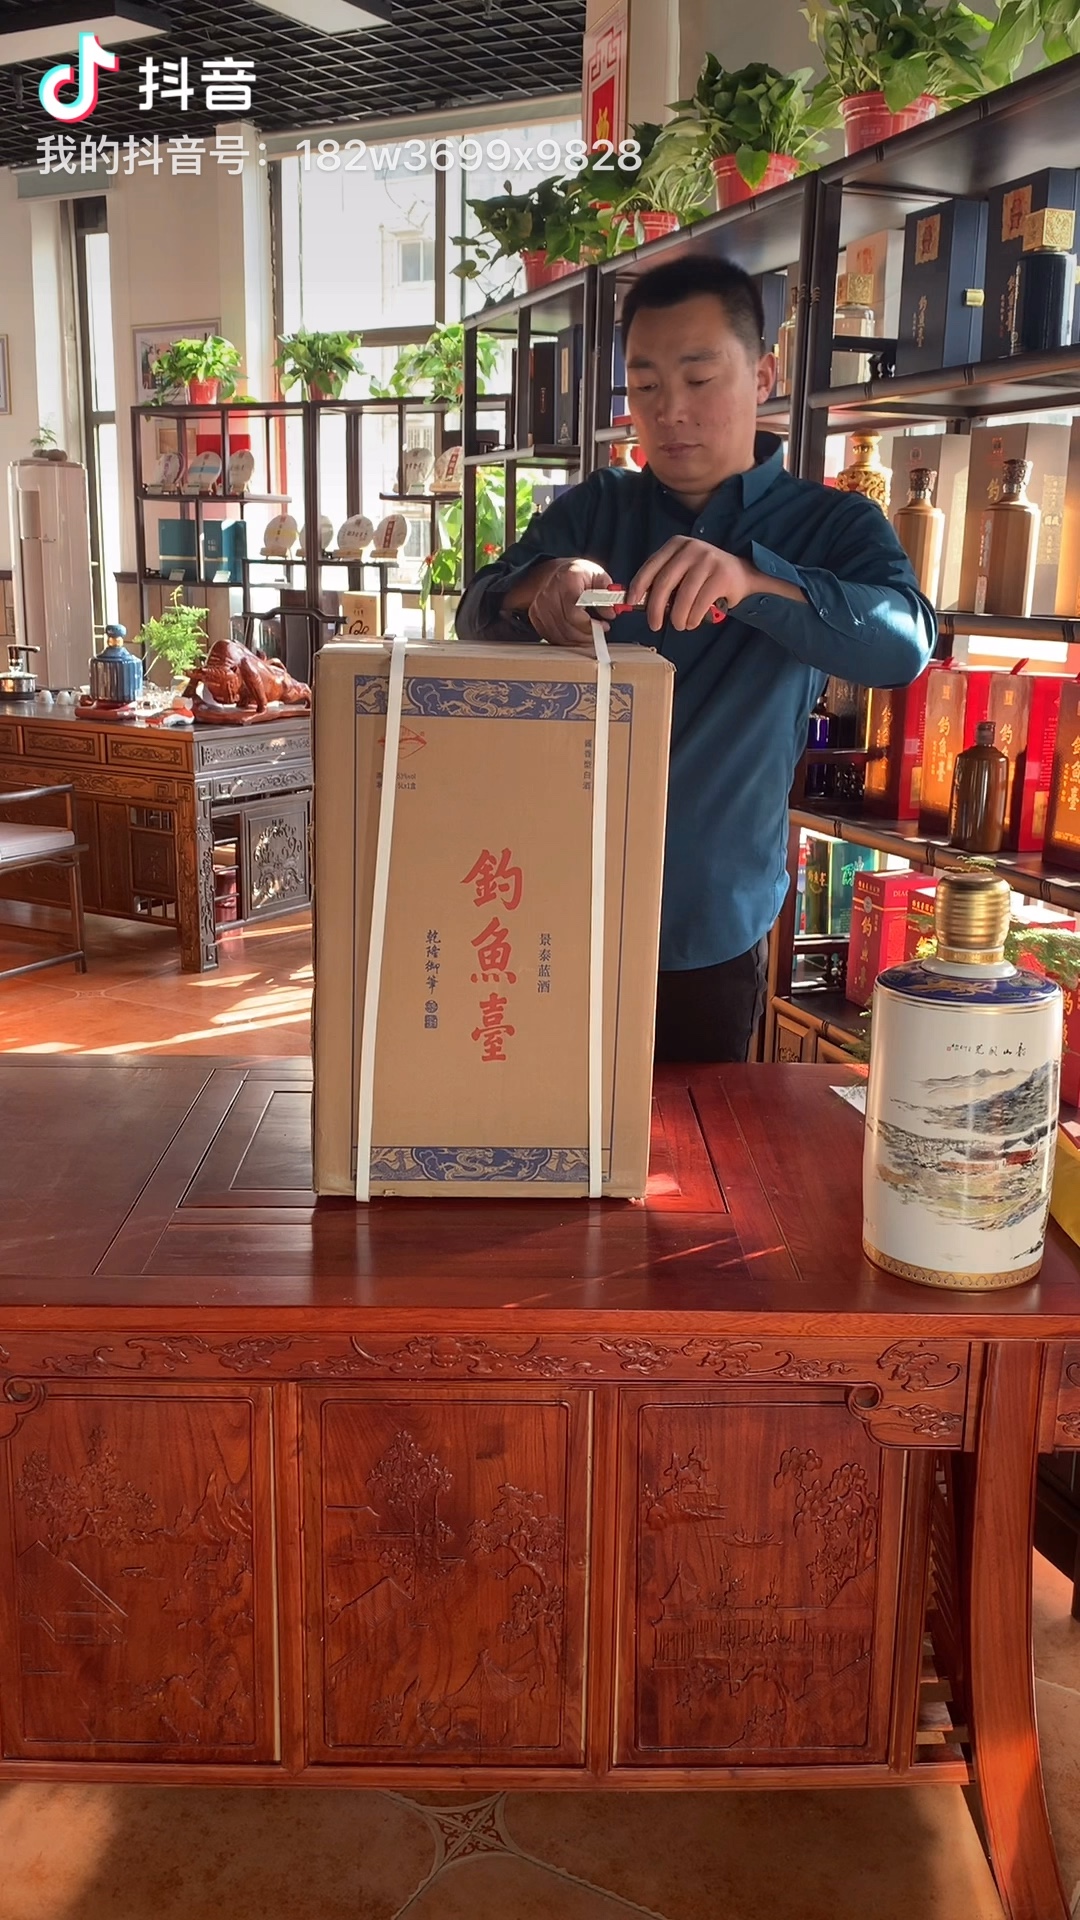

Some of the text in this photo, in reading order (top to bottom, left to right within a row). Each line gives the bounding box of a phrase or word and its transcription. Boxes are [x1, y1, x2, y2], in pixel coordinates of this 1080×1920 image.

[460, 847, 523, 1063] 釣魚臺
[537, 933, 552, 993] 景泰蓝酒
